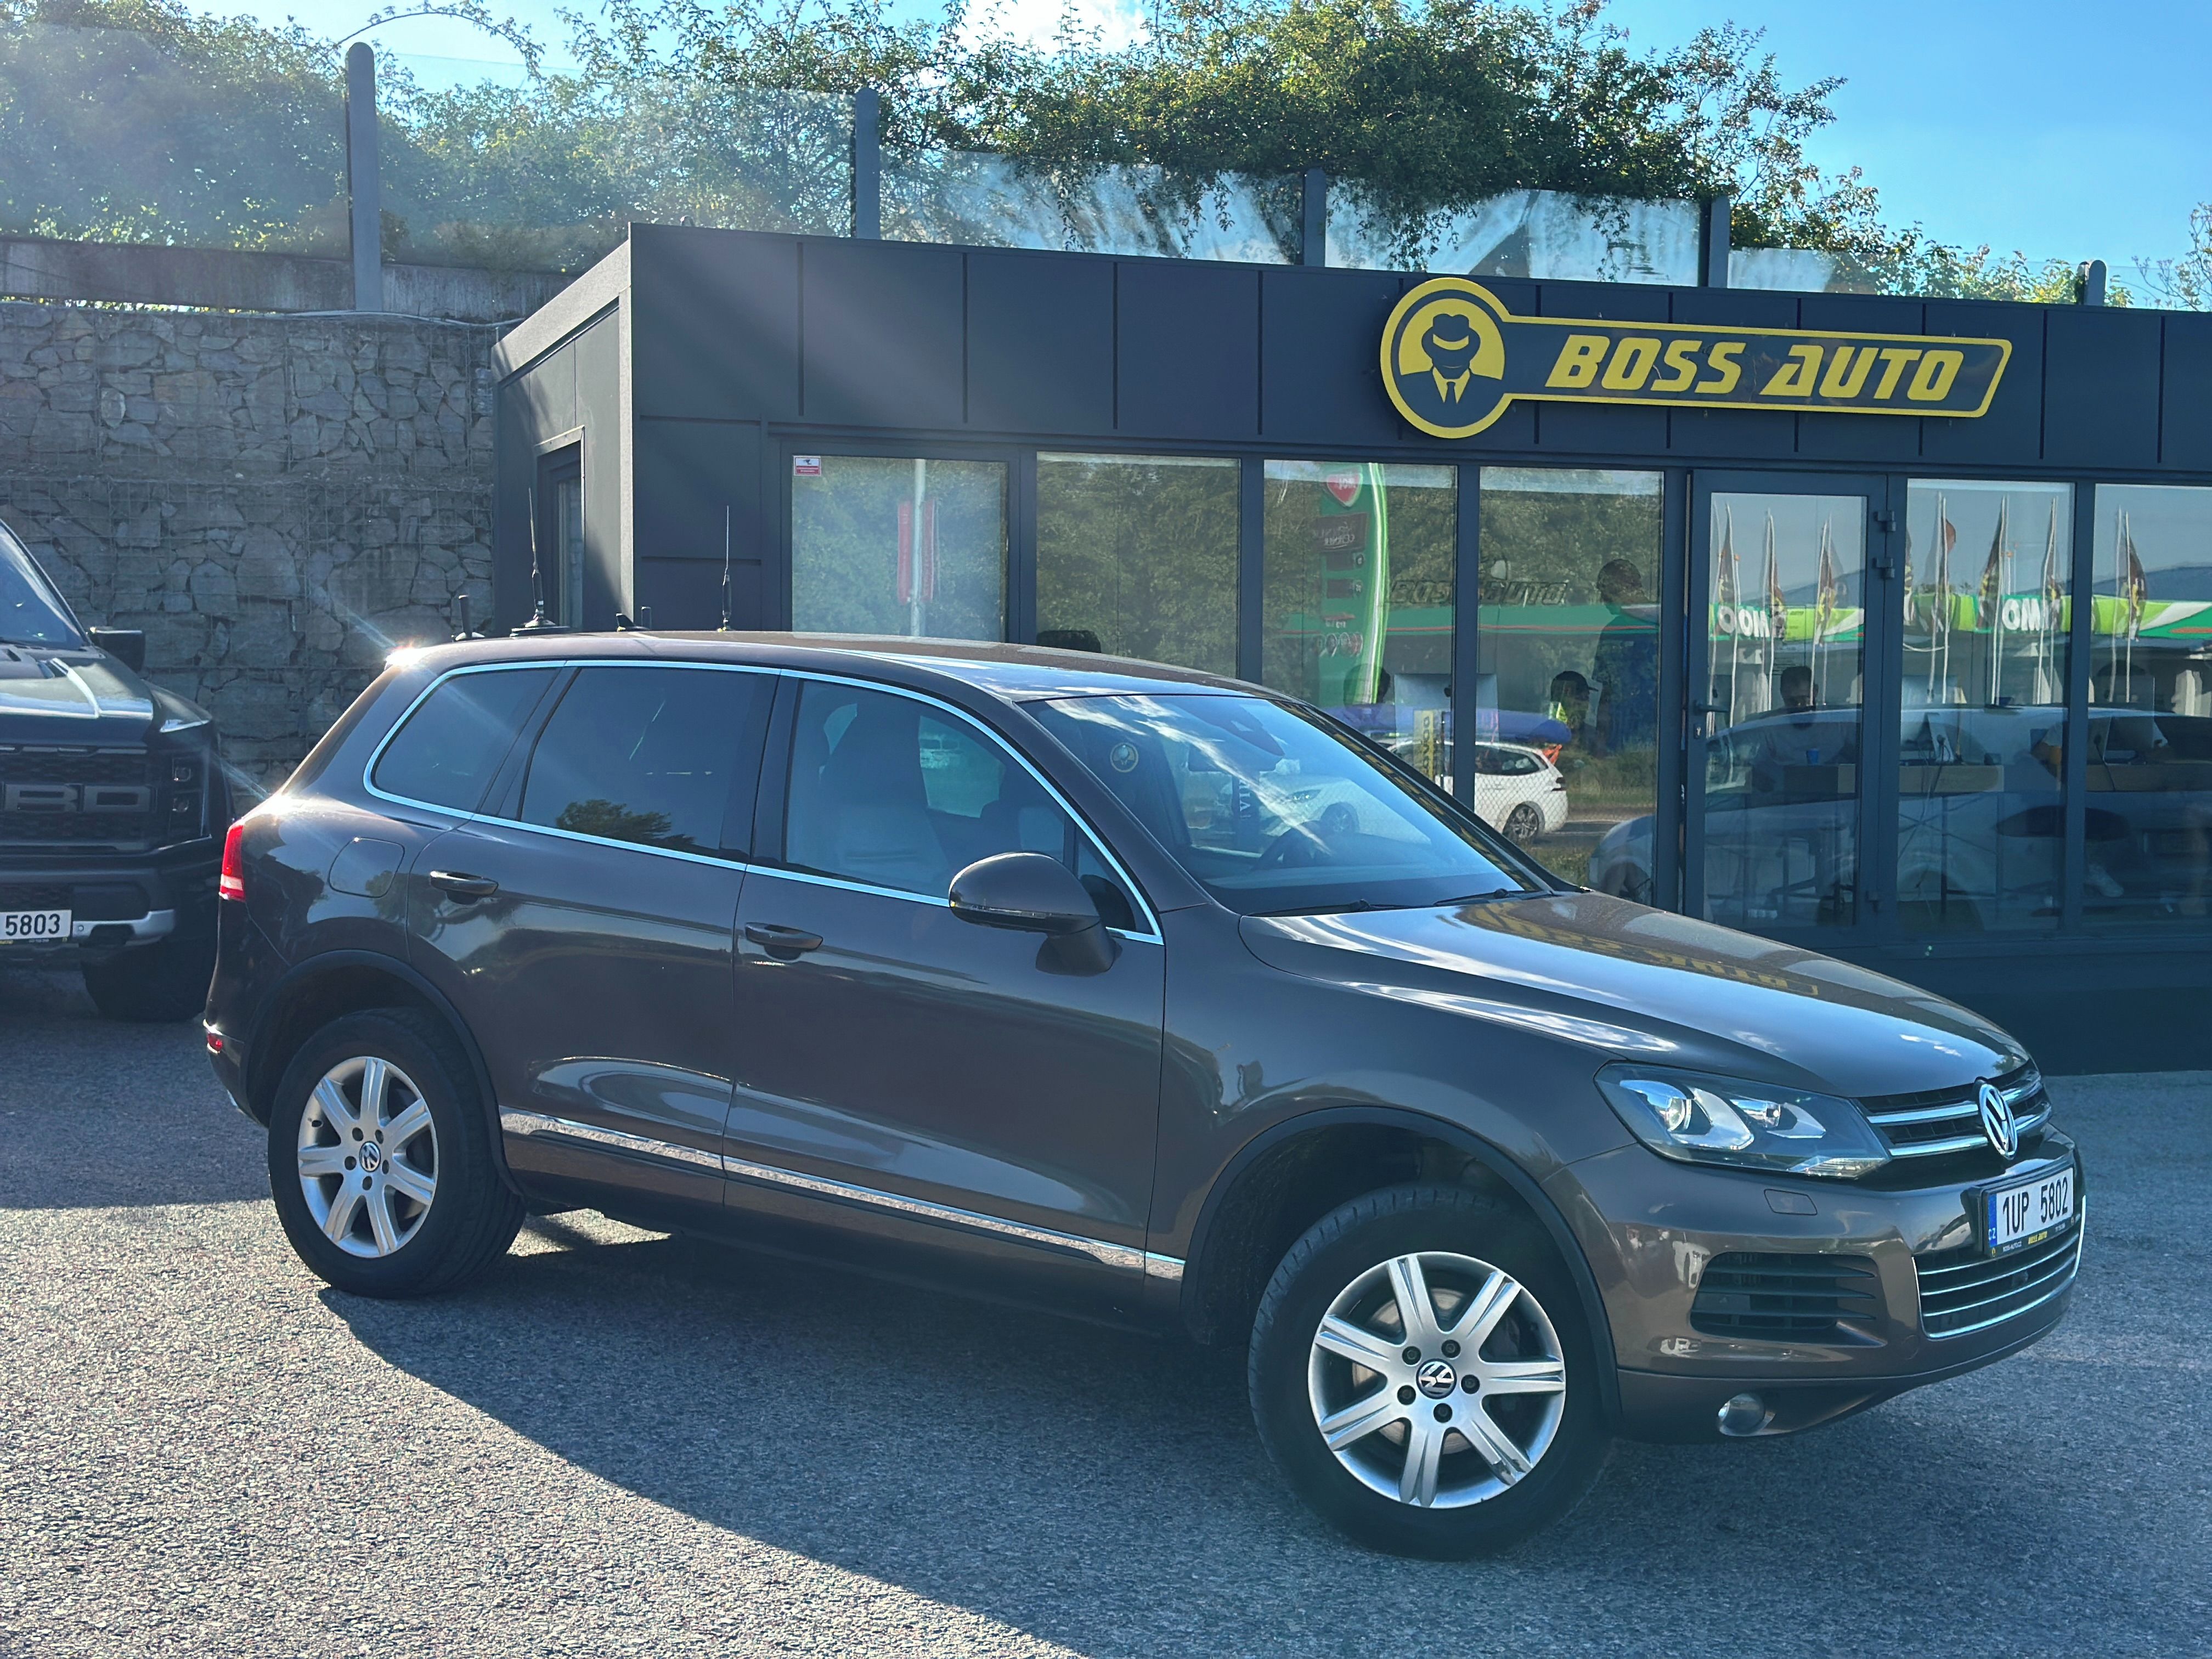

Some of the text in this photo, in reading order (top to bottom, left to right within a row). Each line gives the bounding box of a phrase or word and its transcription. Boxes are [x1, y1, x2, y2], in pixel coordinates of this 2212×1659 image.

[1545, 334, 1964, 401] BOSS AUTO
[5, 913, 60, 936] 5803
[2002, 1176, 2068, 1236] 1UP 5802
[1988, 1227, 1996, 1240] CZ
